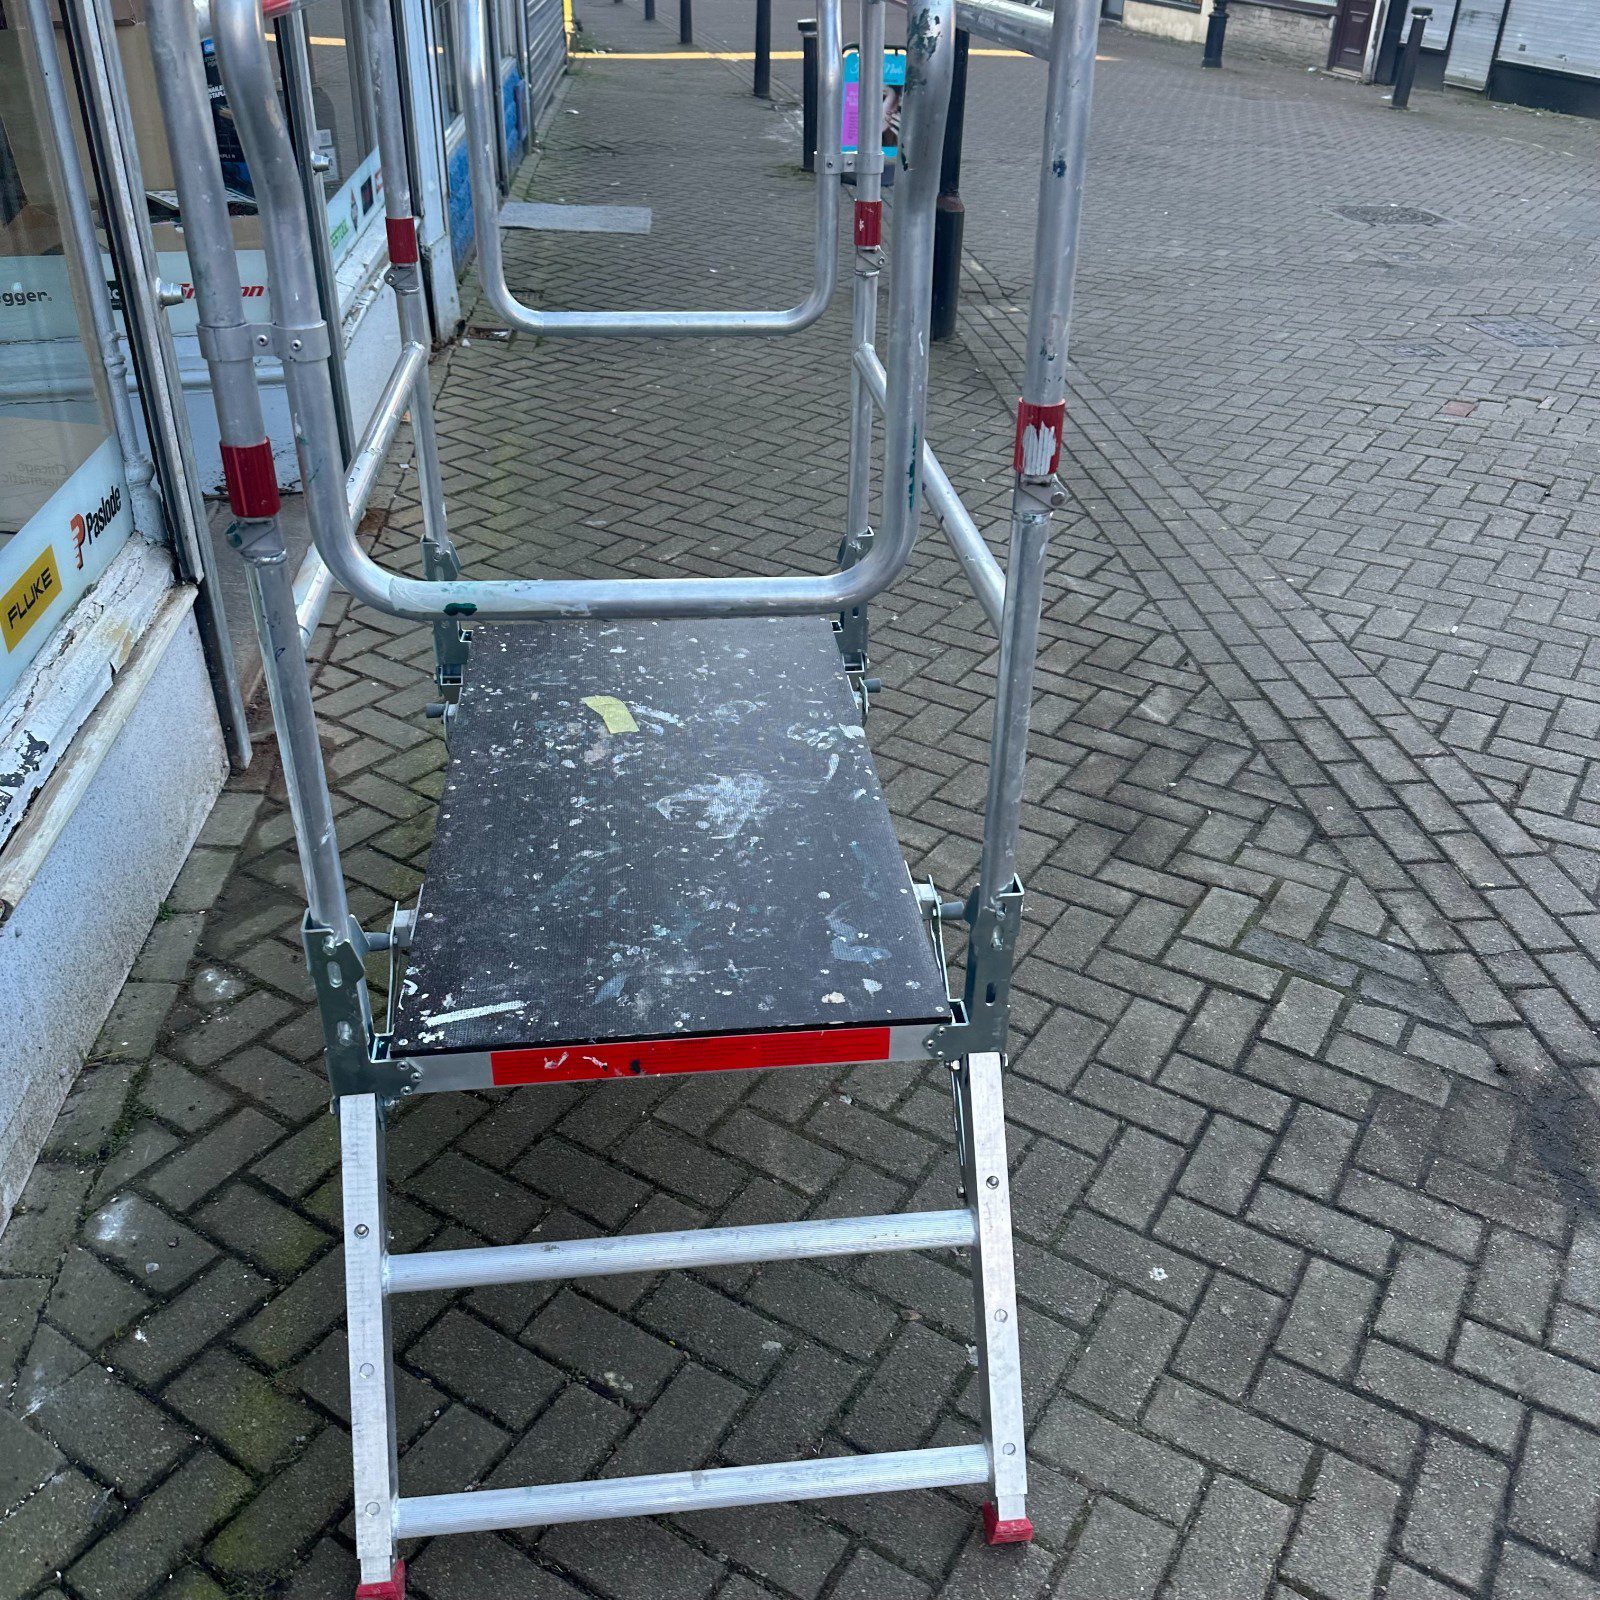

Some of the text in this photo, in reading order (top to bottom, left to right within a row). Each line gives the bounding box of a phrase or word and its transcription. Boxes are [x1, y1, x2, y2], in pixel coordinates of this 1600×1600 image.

[0, 290, 53, 306] gger.
[85, 485, 122, 546] Paslode
[7, 566, 53, 630] FLUKE
